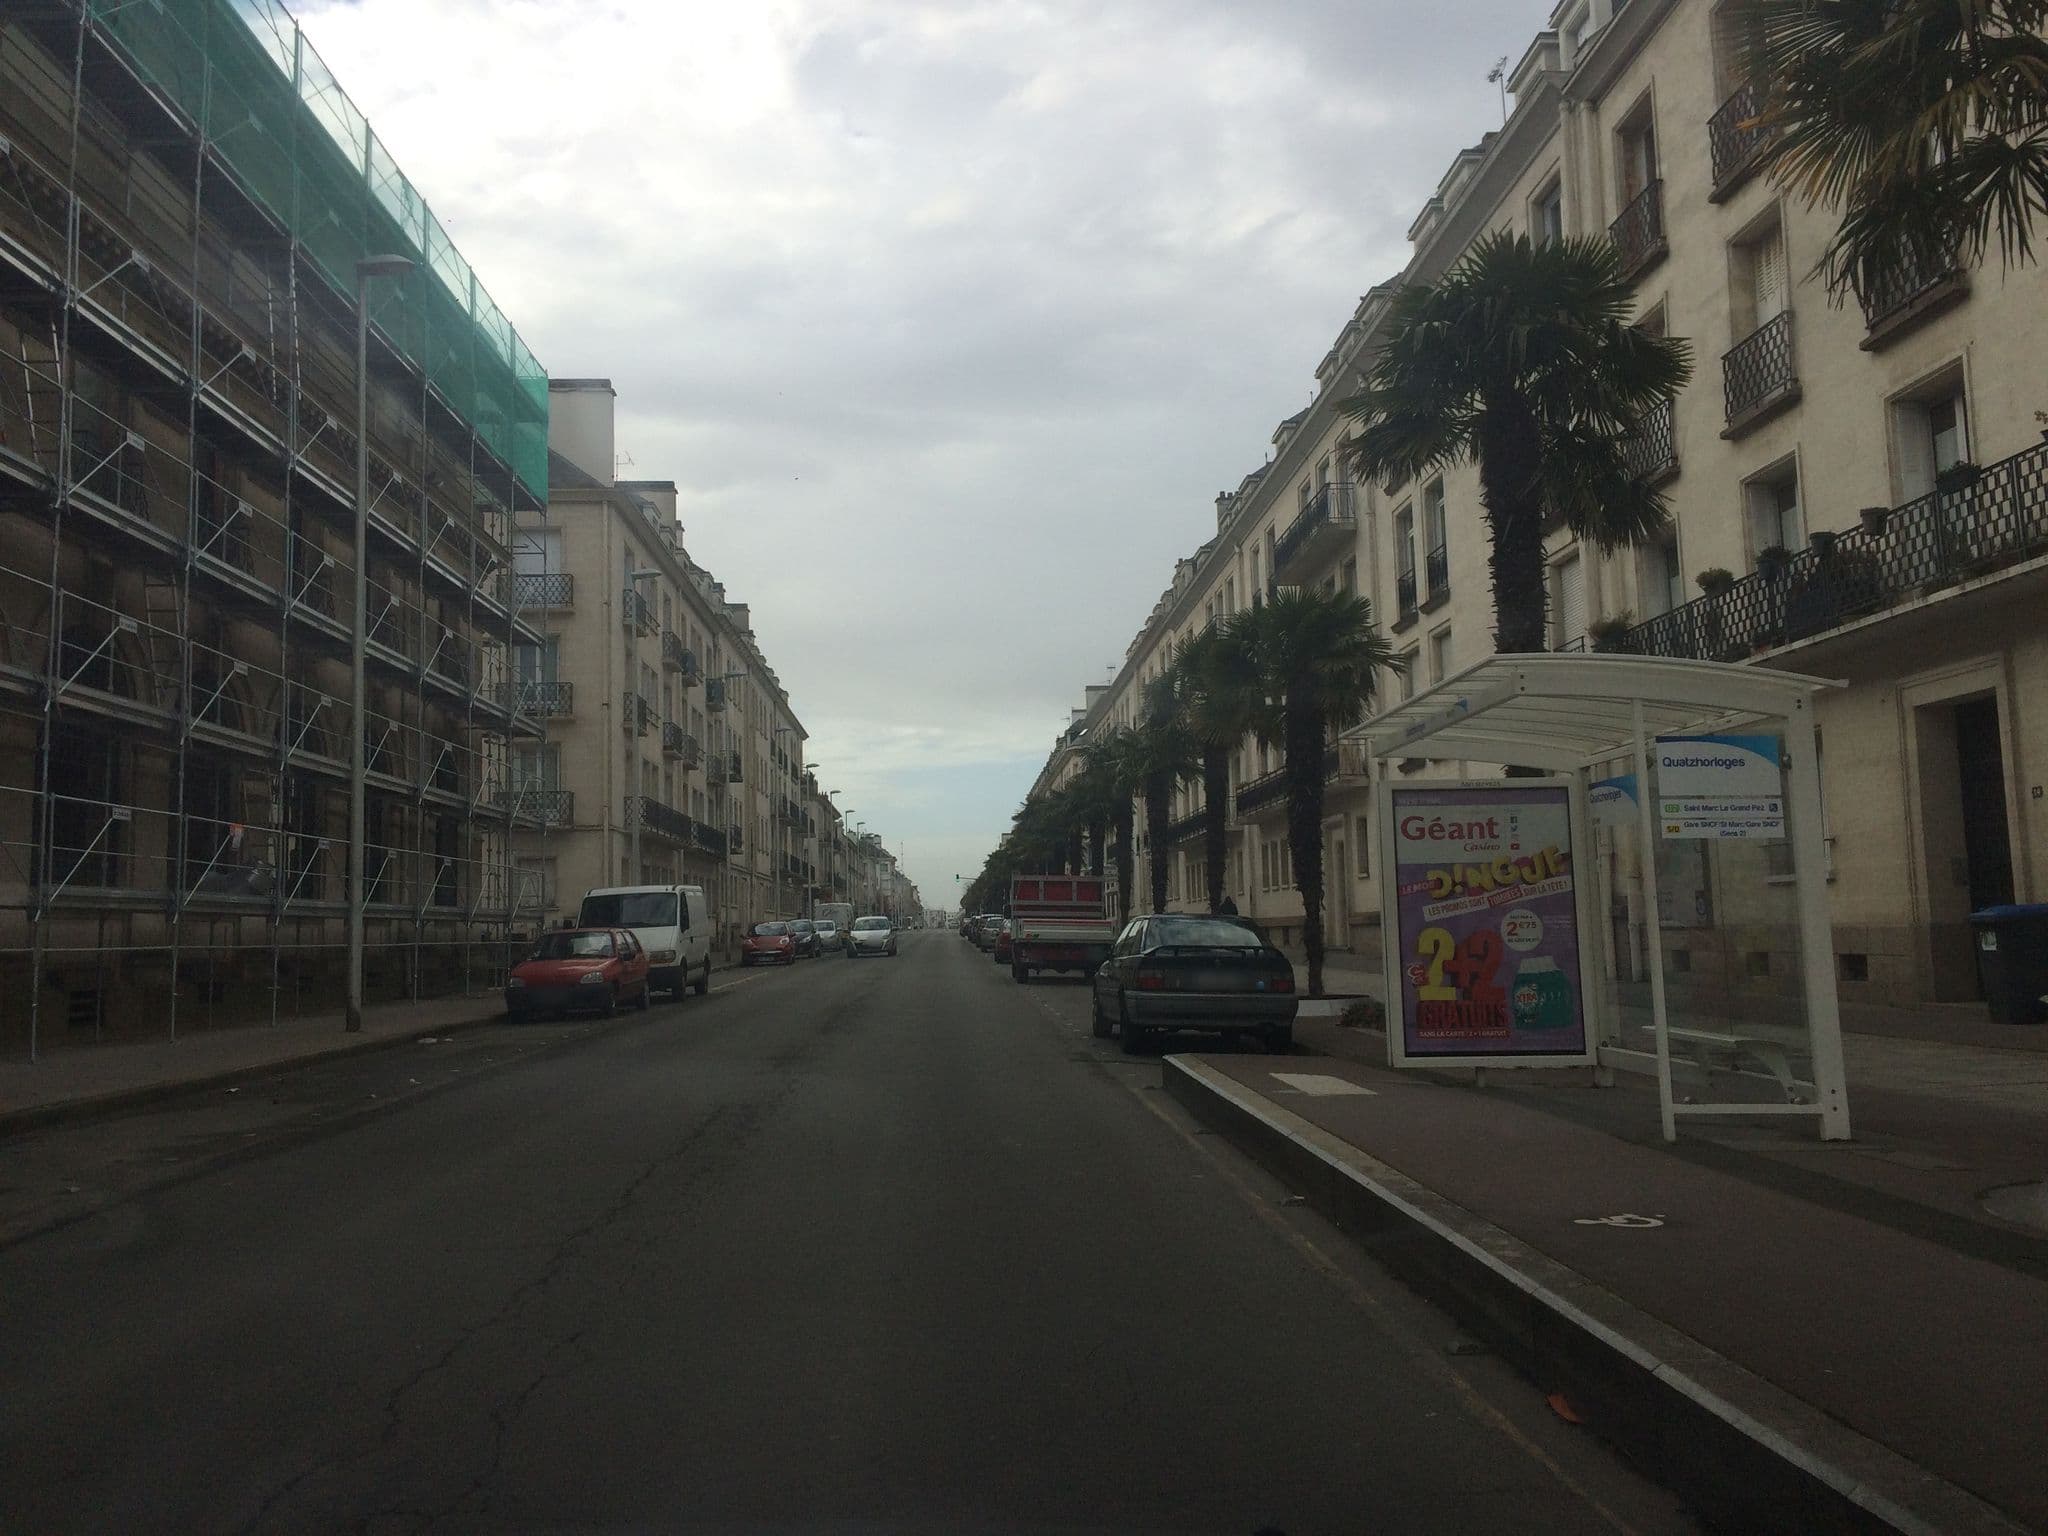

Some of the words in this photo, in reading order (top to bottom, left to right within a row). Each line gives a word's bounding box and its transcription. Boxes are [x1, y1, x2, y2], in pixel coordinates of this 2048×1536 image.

[1663, 757, 1745, 769] Quatzhorloges
[1683, 804, 1700, 812] Saint
[1702, 804, 1718, 812] Marc
[1730, 804, 1751, 812] Grand
[1401, 815, 1499, 841] Géant
[1464, 841, 1500, 853] Casino
